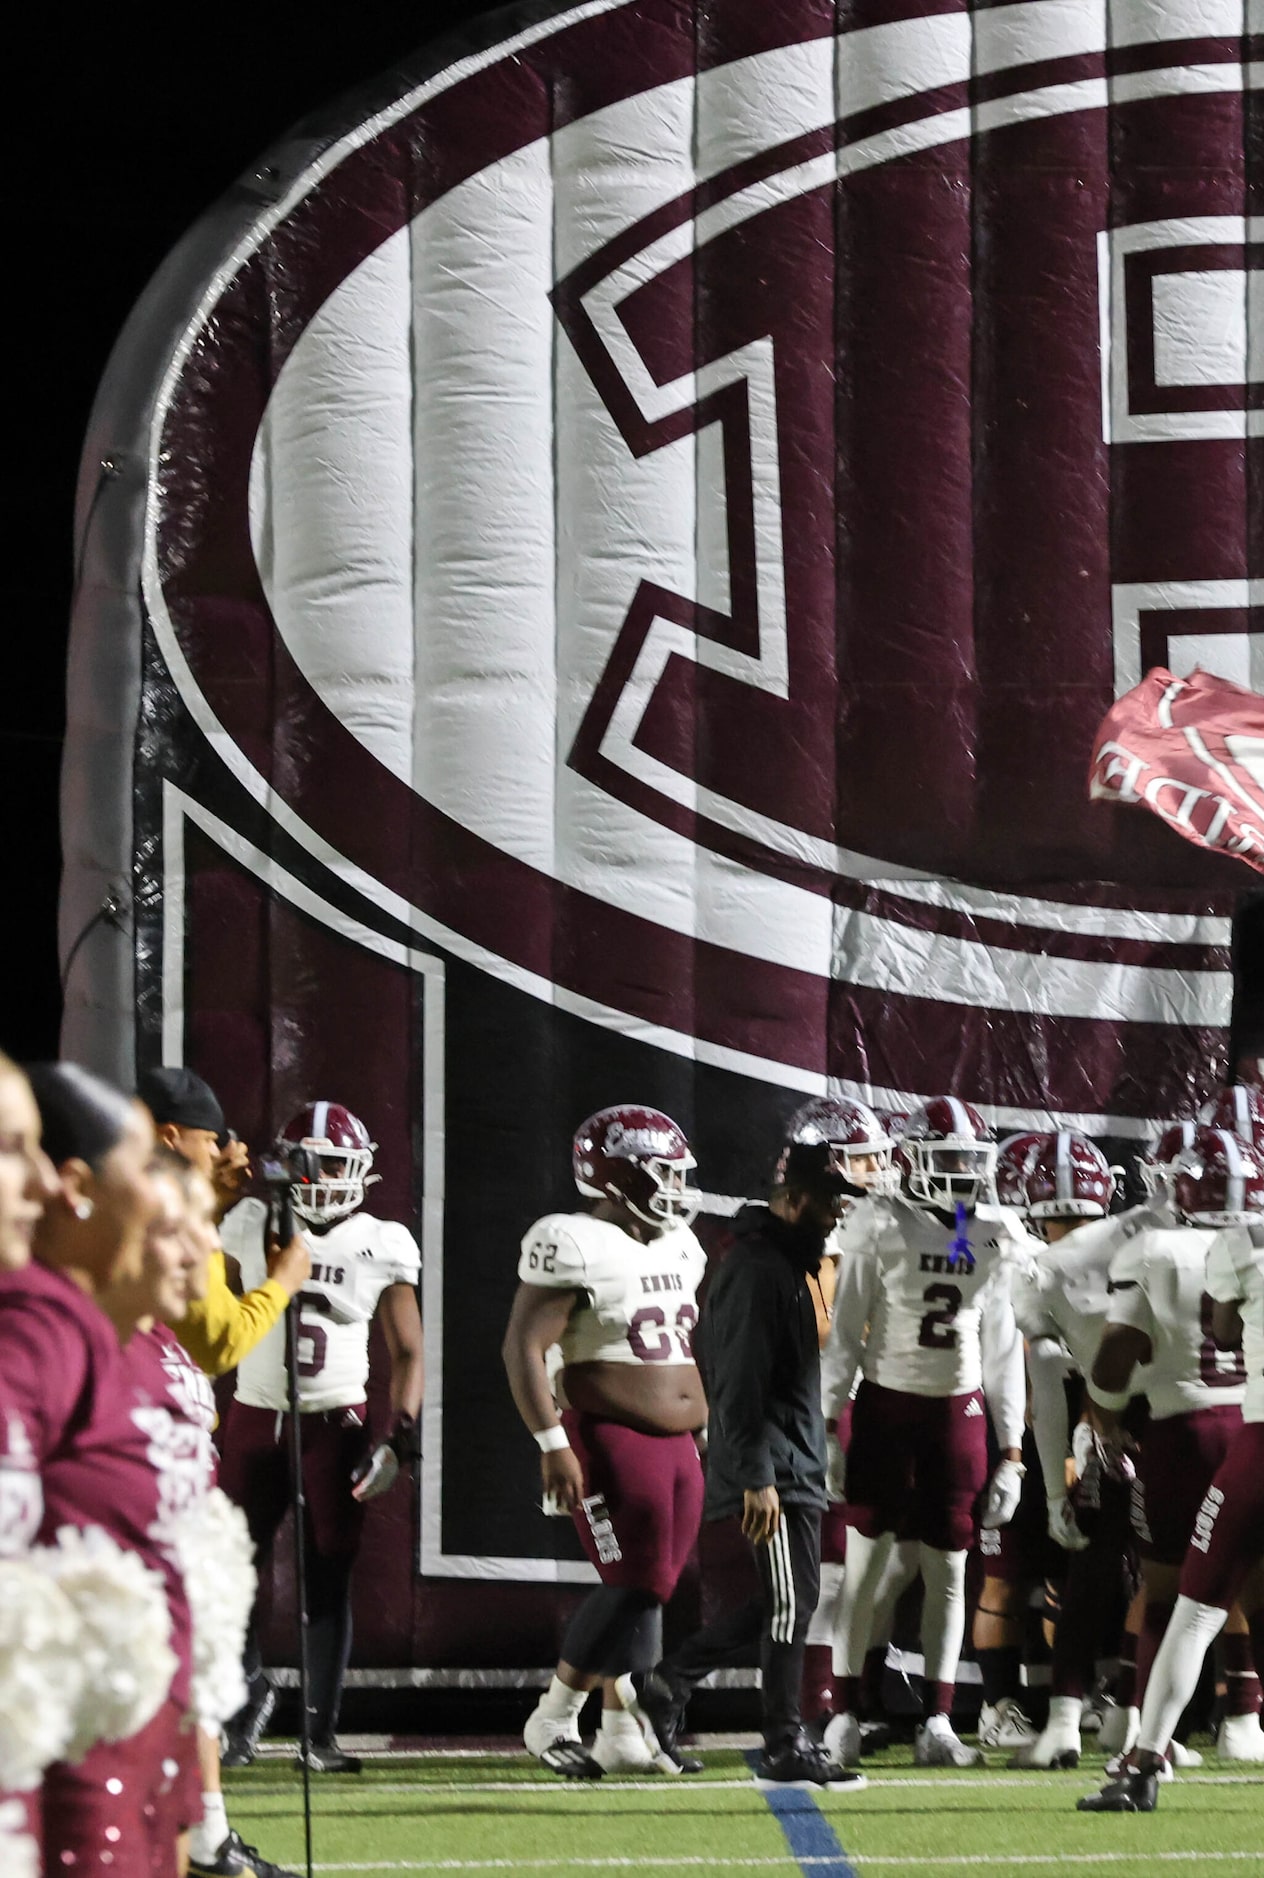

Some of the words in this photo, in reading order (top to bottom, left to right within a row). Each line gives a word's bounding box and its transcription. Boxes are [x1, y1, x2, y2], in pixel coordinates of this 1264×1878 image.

[529, 1242, 558, 1273] 62
[311, 1263, 345, 1285] NIS
[640, 1274, 682, 1293] ENNIS
[917, 1282, 963, 1349] 2
[1189, 1484, 1226, 1554] LIONS
